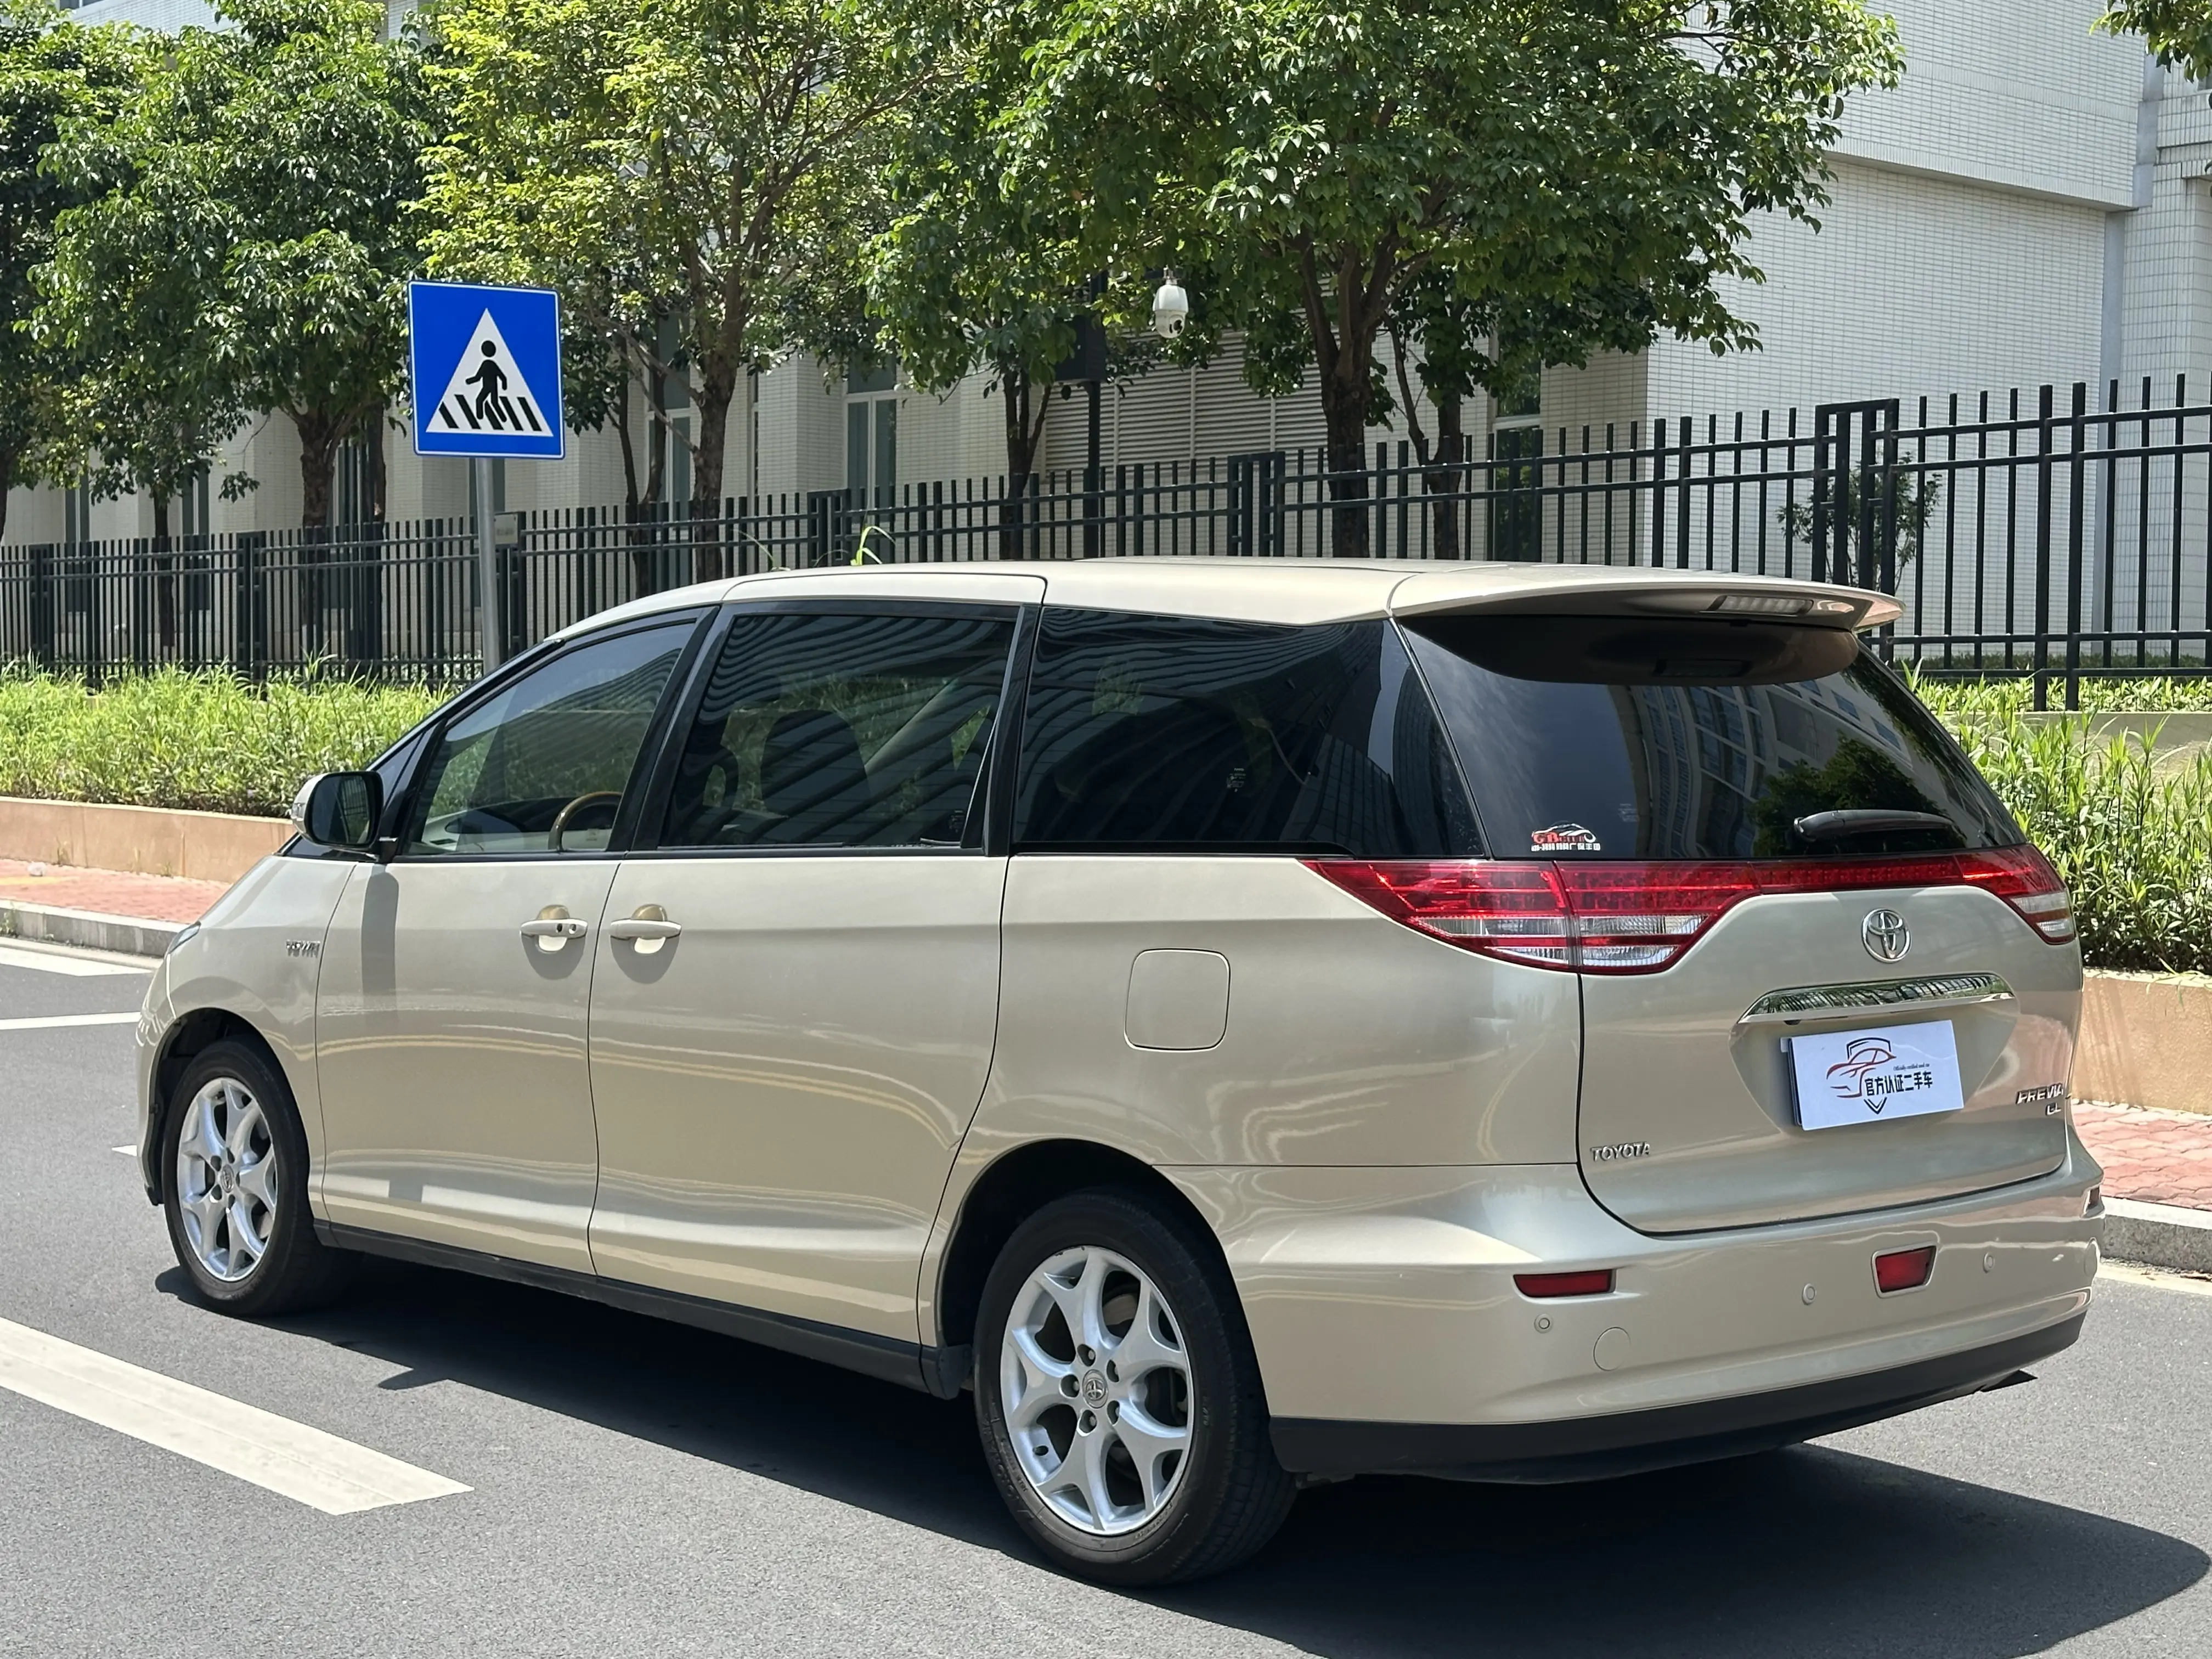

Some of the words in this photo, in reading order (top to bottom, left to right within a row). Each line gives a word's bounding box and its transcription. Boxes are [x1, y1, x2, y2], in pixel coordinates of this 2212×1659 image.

[1865, 1071, 1933, 1096] 官方认证二手车
[1590, 1141, 1651, 1162] TOYOTA
